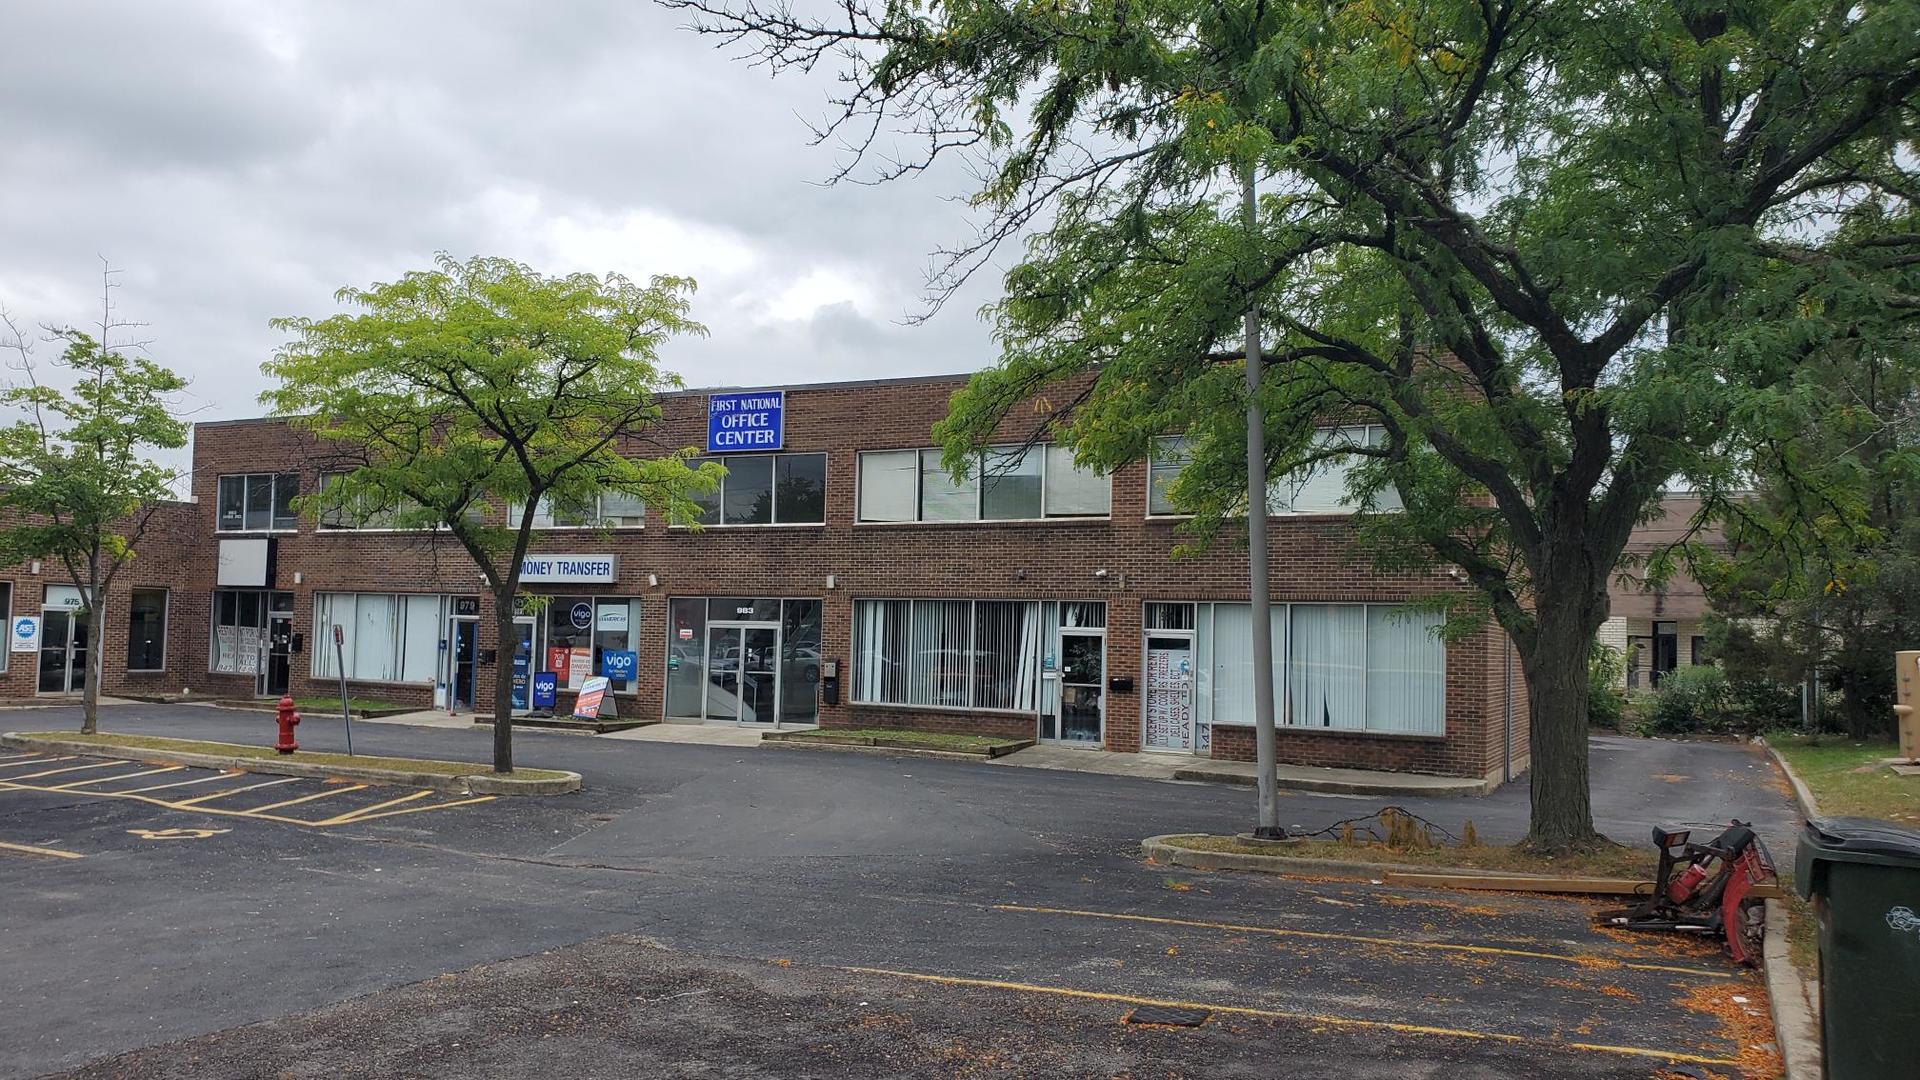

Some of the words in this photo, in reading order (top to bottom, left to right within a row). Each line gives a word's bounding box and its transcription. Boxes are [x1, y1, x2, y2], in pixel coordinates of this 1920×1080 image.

[711, 400, 737, 412] FIRST
[741, 397, 782, 410] NATIONAL
[721, 413, 769, 428] OFFICE
[715, 430, 775, 445] CENTER
[519, 561, 553, 575] MONEY
[557, 561, 610, 576] TRANSFER
[459, 600, 475, 610] 979
[573, 609, 591, 619] vigo
[606, 653, 631, 668] vigo
[535, 680, 554, 692] vigo
[1147, 672, 1158, 688] FOR
[1147, 689, 1158, 713] STORE
[1181, 704, 1190, 748] READY
